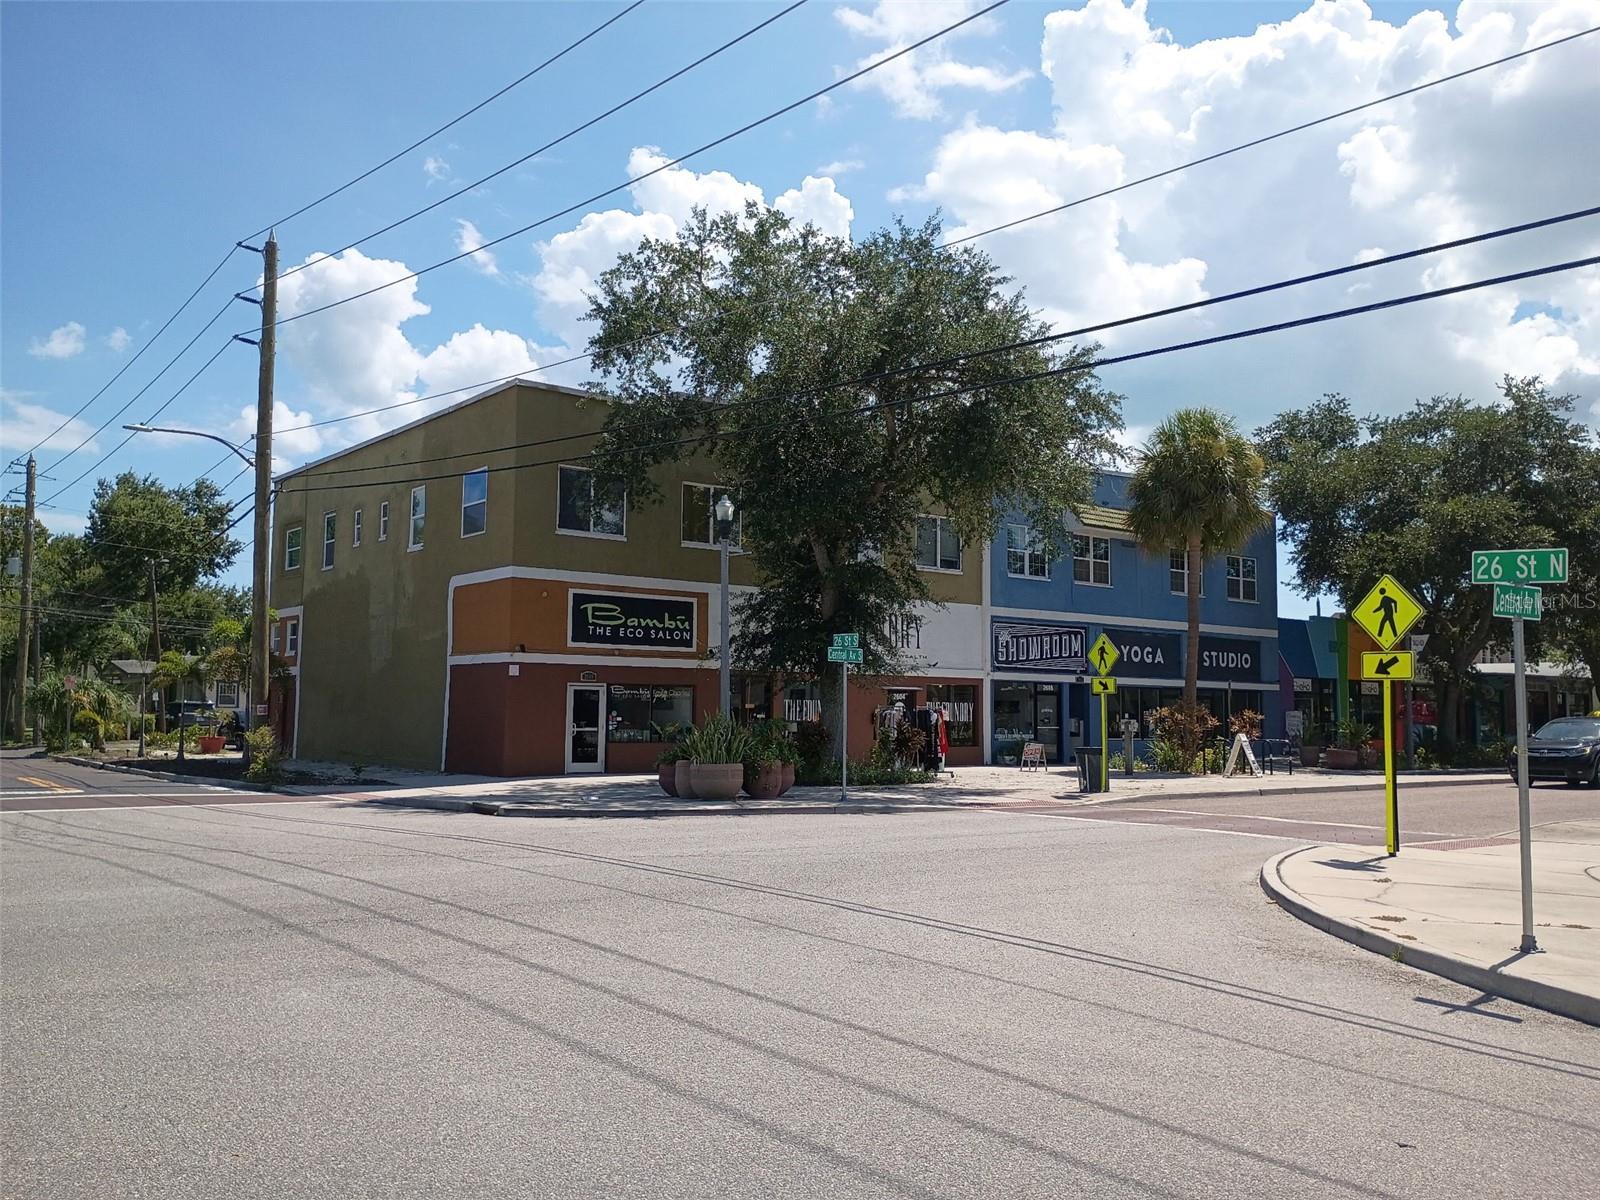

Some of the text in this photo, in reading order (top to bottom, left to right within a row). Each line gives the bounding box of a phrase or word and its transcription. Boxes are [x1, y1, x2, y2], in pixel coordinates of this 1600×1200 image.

[1476, 553, 1563, 579] 26 St N
[1494, 587, 1522, 614] Central
[588, 626, 690, 640] THE ECO SALON
[834, 636, 858, 646] 26 St S
[828, 650, 847, 660] Central
[858, 651, 863, 660] S
[998, 634, 1081, 661] SHOWROOM
[1121, 645, 1251, 668] YOGA STUDIO
[784, 700, 801, 721] THE
